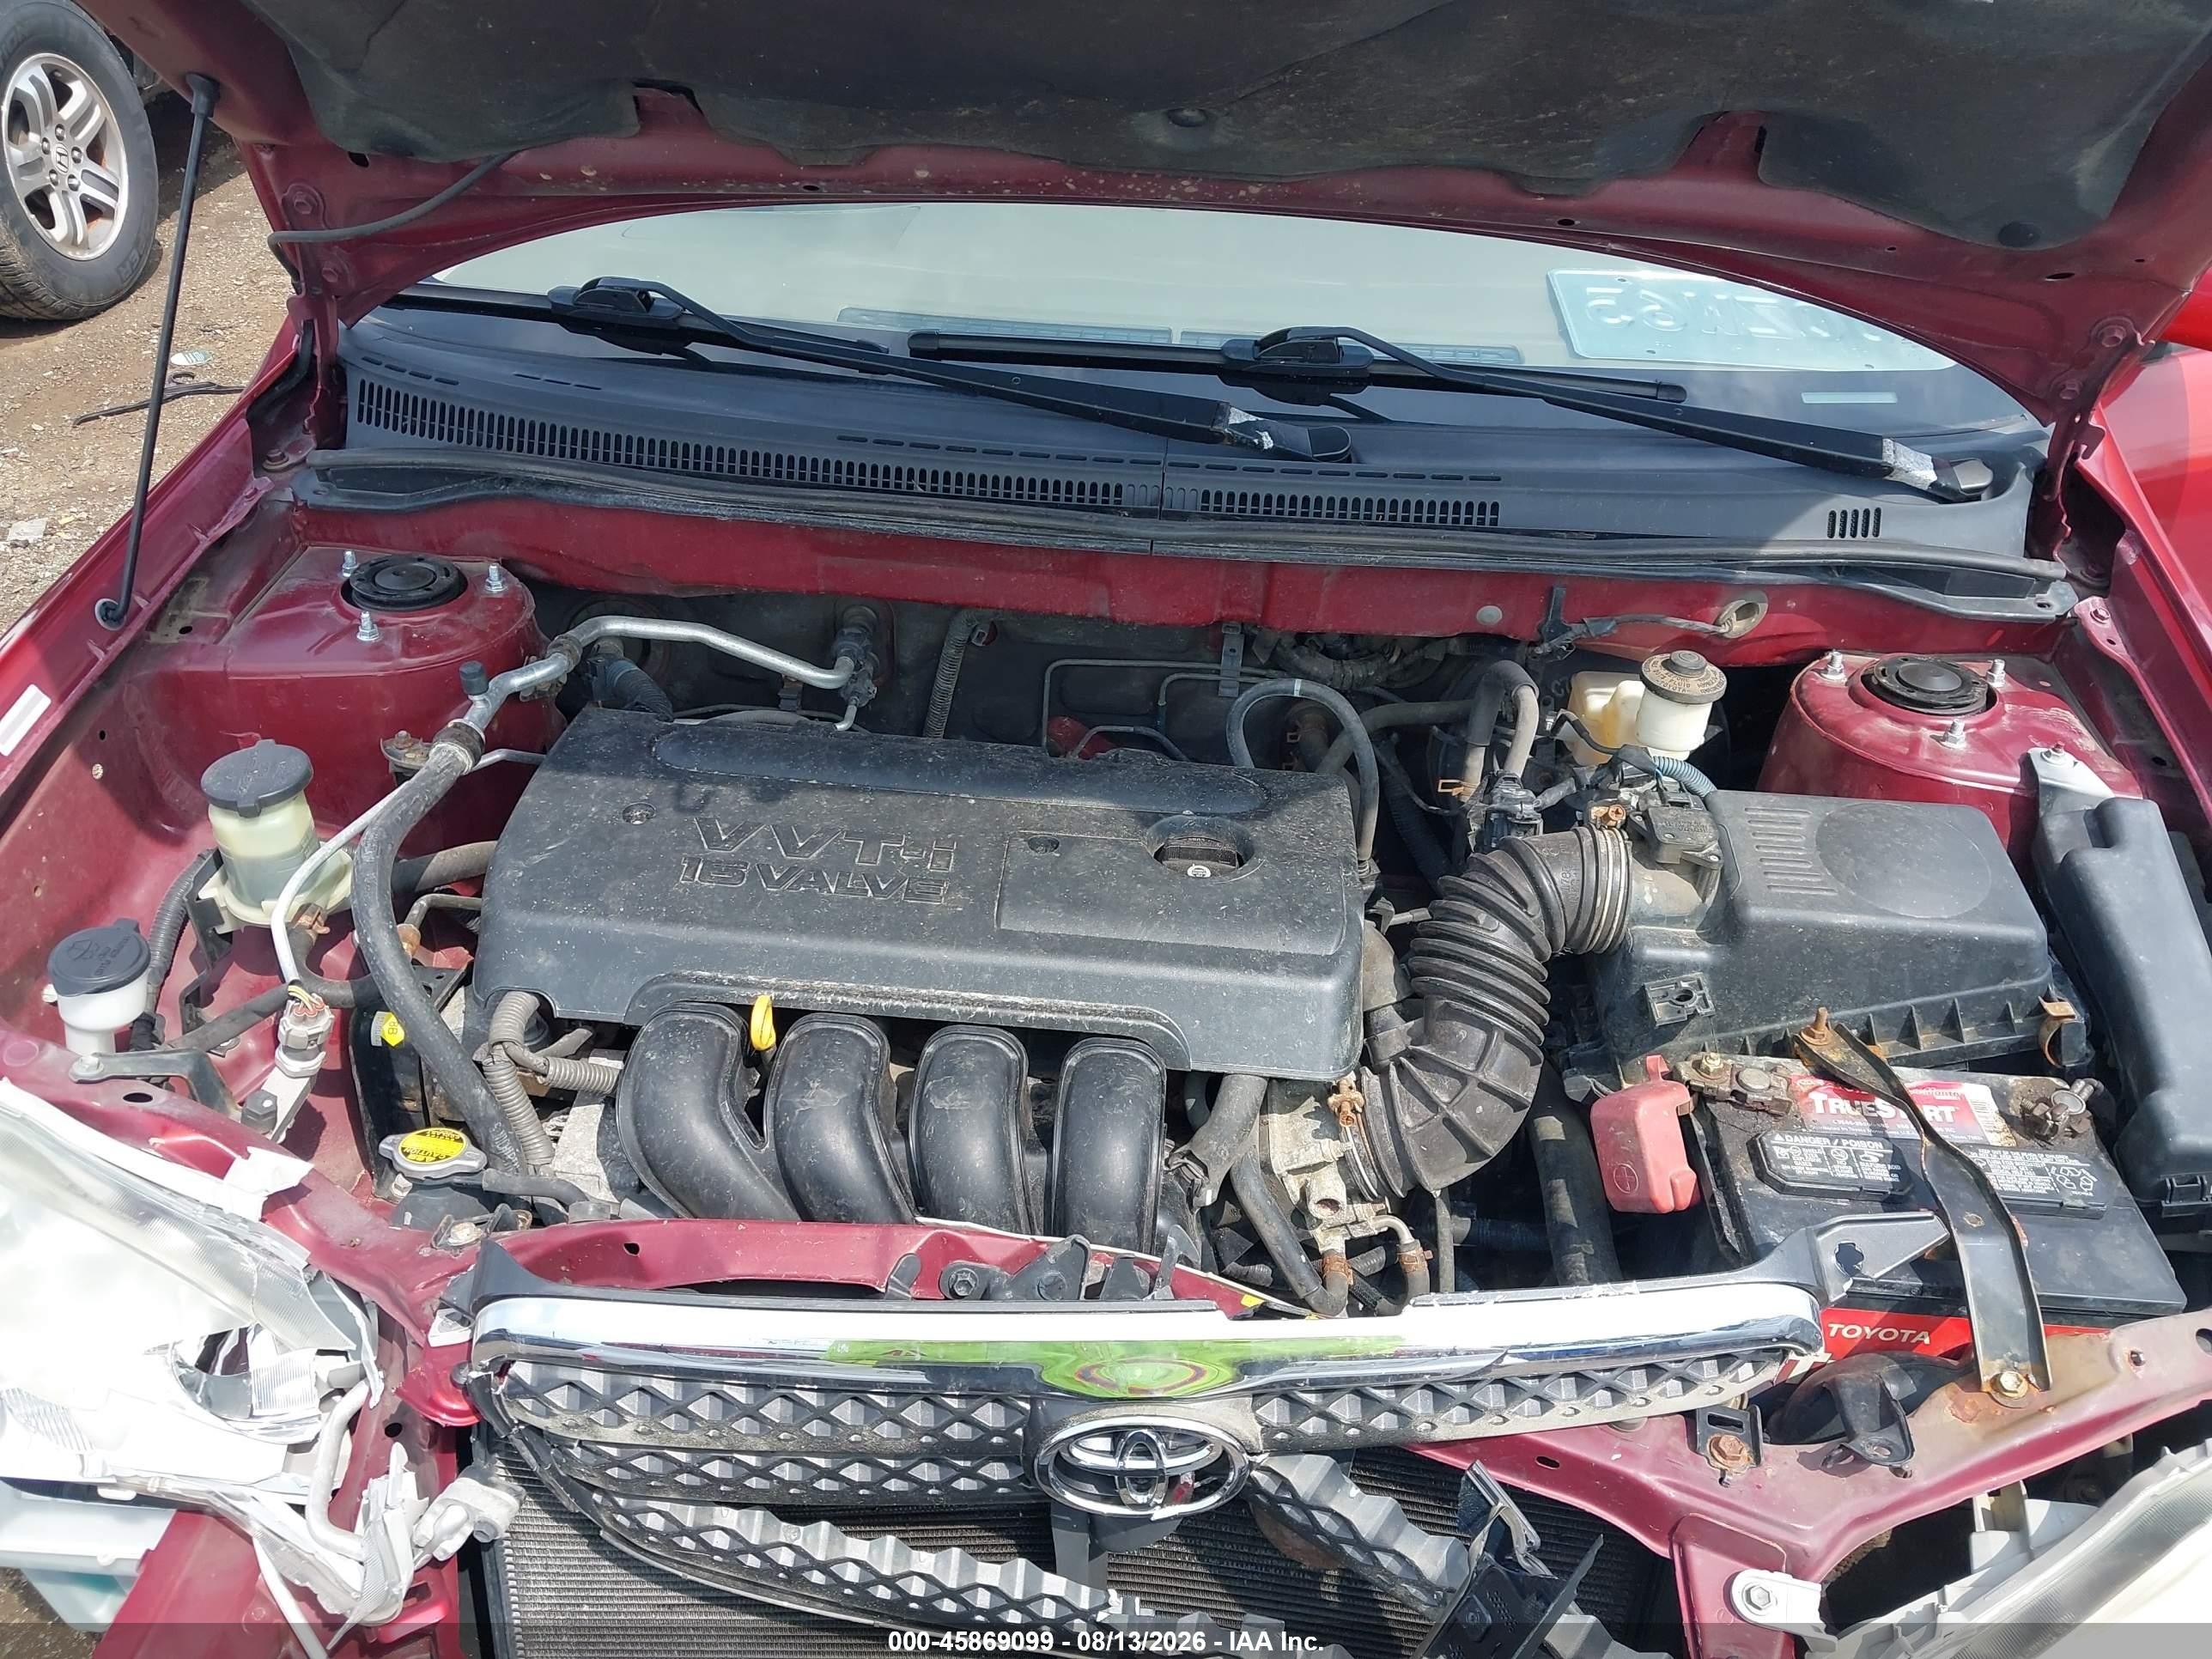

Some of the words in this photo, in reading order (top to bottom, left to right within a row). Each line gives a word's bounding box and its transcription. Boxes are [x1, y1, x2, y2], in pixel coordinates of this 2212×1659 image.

[679, 856, 750, 888] 16
[755, 861, 950, 905] VALVE
[1785, 1135, 1831, 1146] DANGER
[1843, 1139, 1884, 1150] POISON
[1827, 1323, 1931, 1345] TOYOTA
